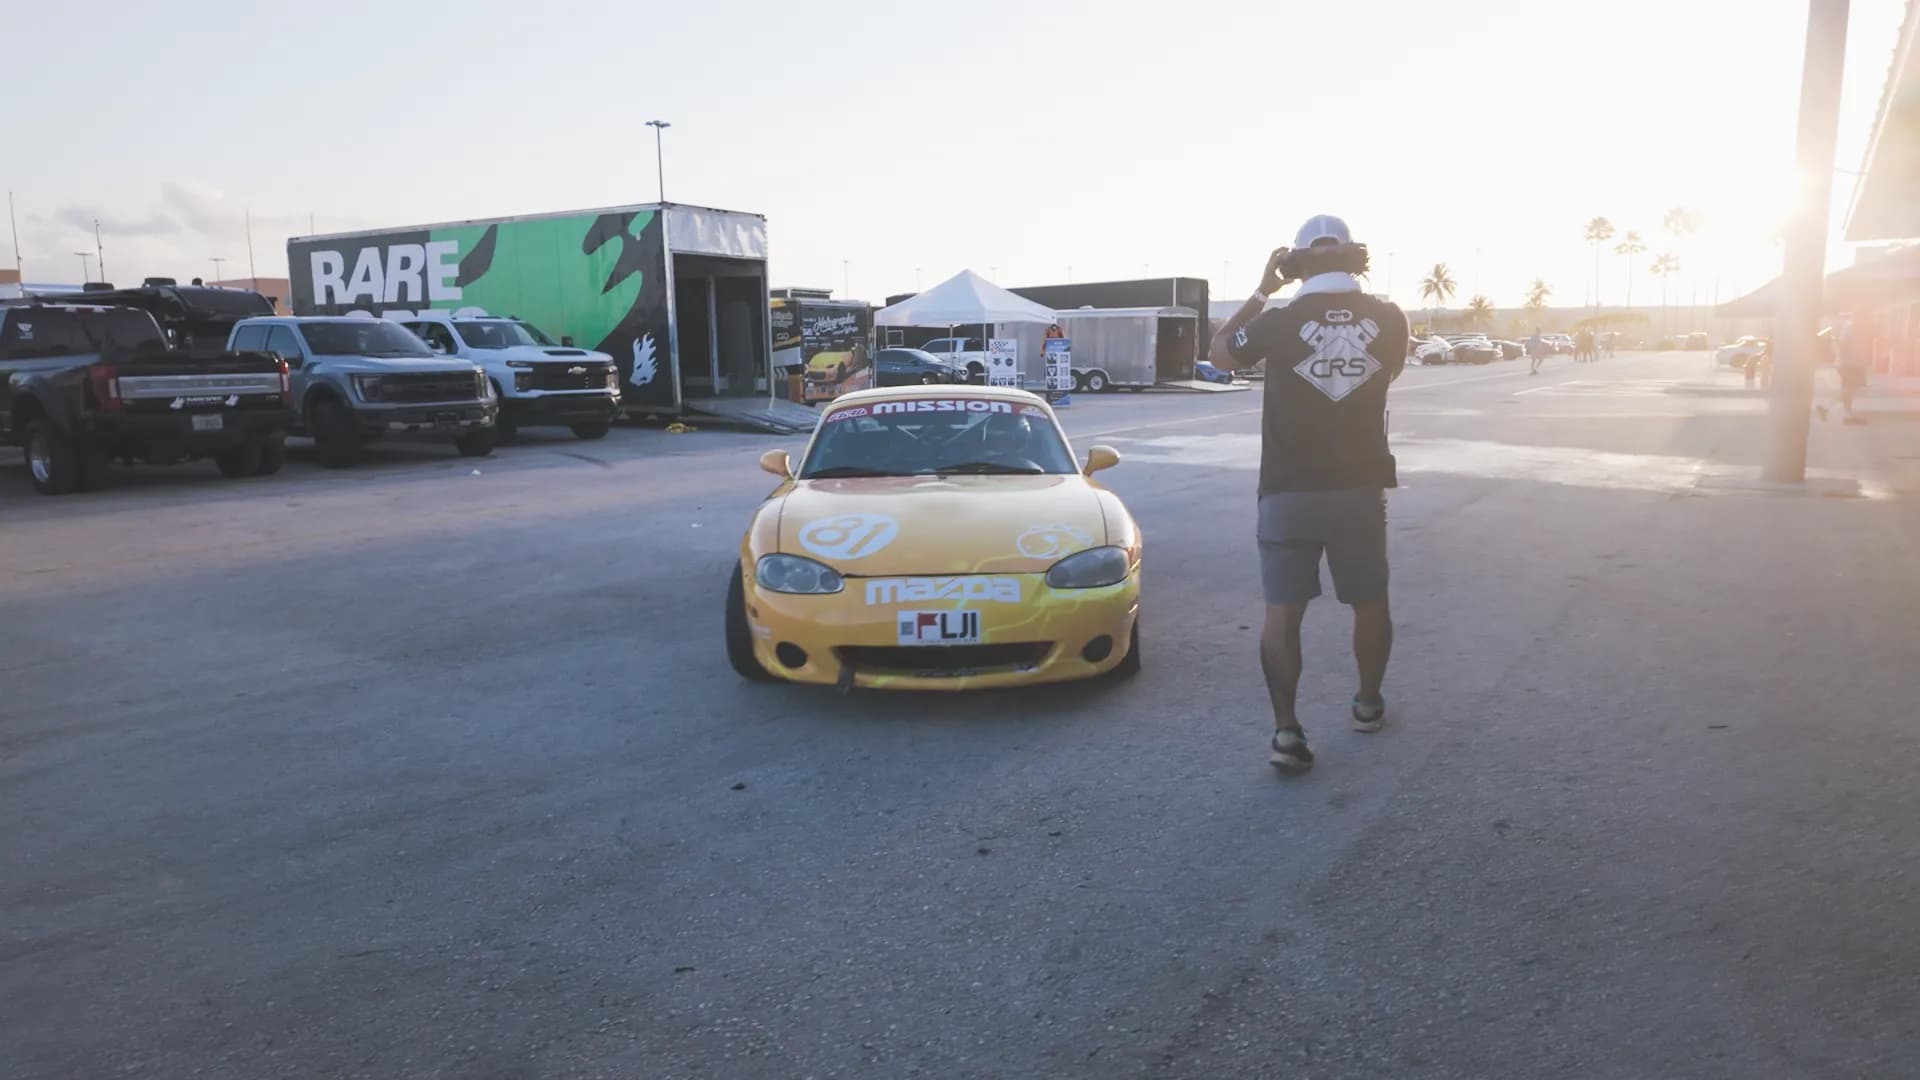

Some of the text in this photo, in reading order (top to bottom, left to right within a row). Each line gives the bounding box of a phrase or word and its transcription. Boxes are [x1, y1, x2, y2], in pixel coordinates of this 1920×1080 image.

[311, 240, 463, 305] RARE
[1310, 358, 1367, 378] CRS
[872, 400, 1012, 415] mission
